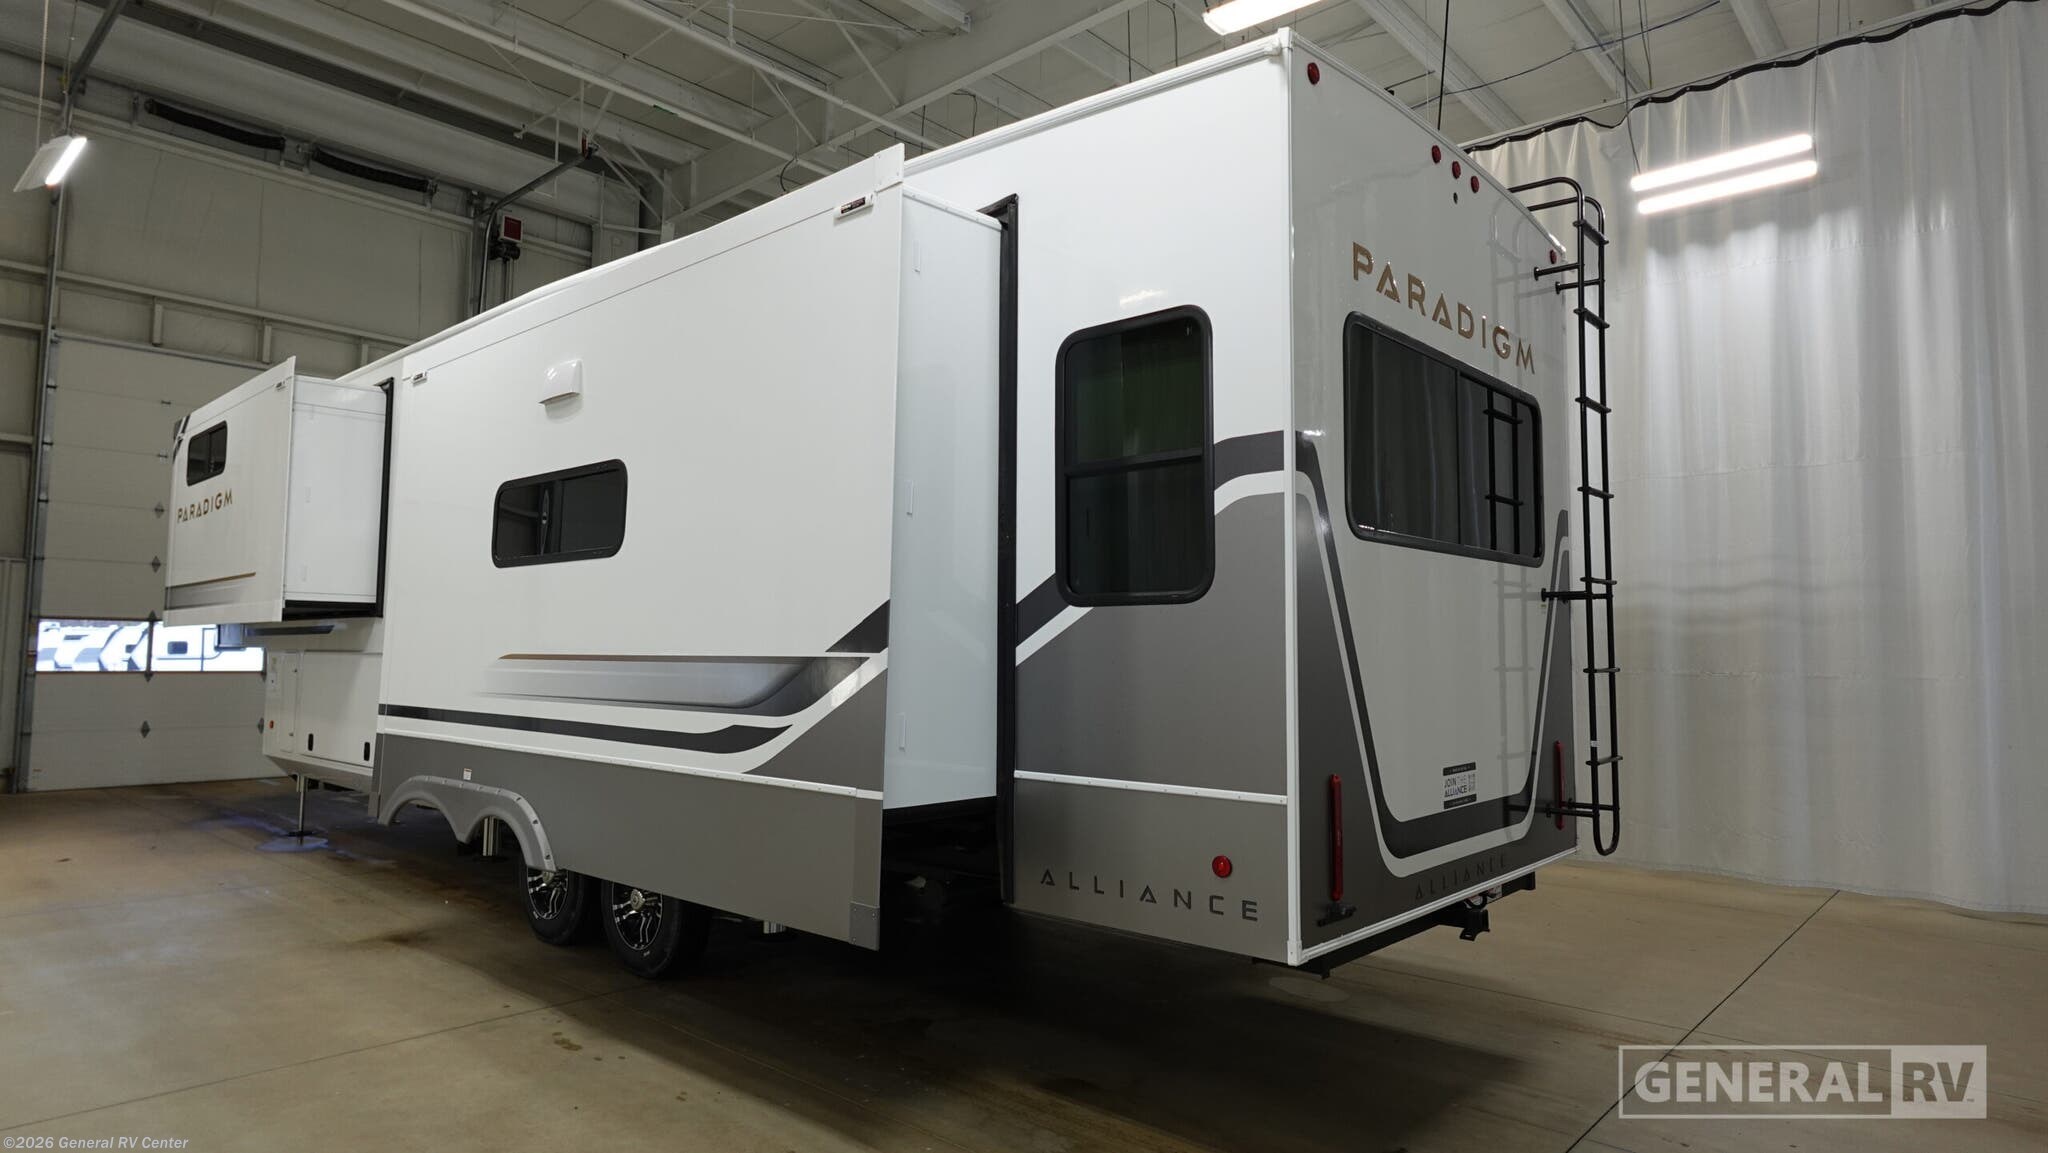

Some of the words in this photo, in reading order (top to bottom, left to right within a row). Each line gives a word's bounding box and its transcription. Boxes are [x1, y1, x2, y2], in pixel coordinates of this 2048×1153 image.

[1353, 242, 1535, 375] PARADIGM
[177, 488, 233, 523] PARADIGM
[1041, 869, 1258, 921] ALLIANCE
[1415, 854, 1508, 900] ALLIANCE
